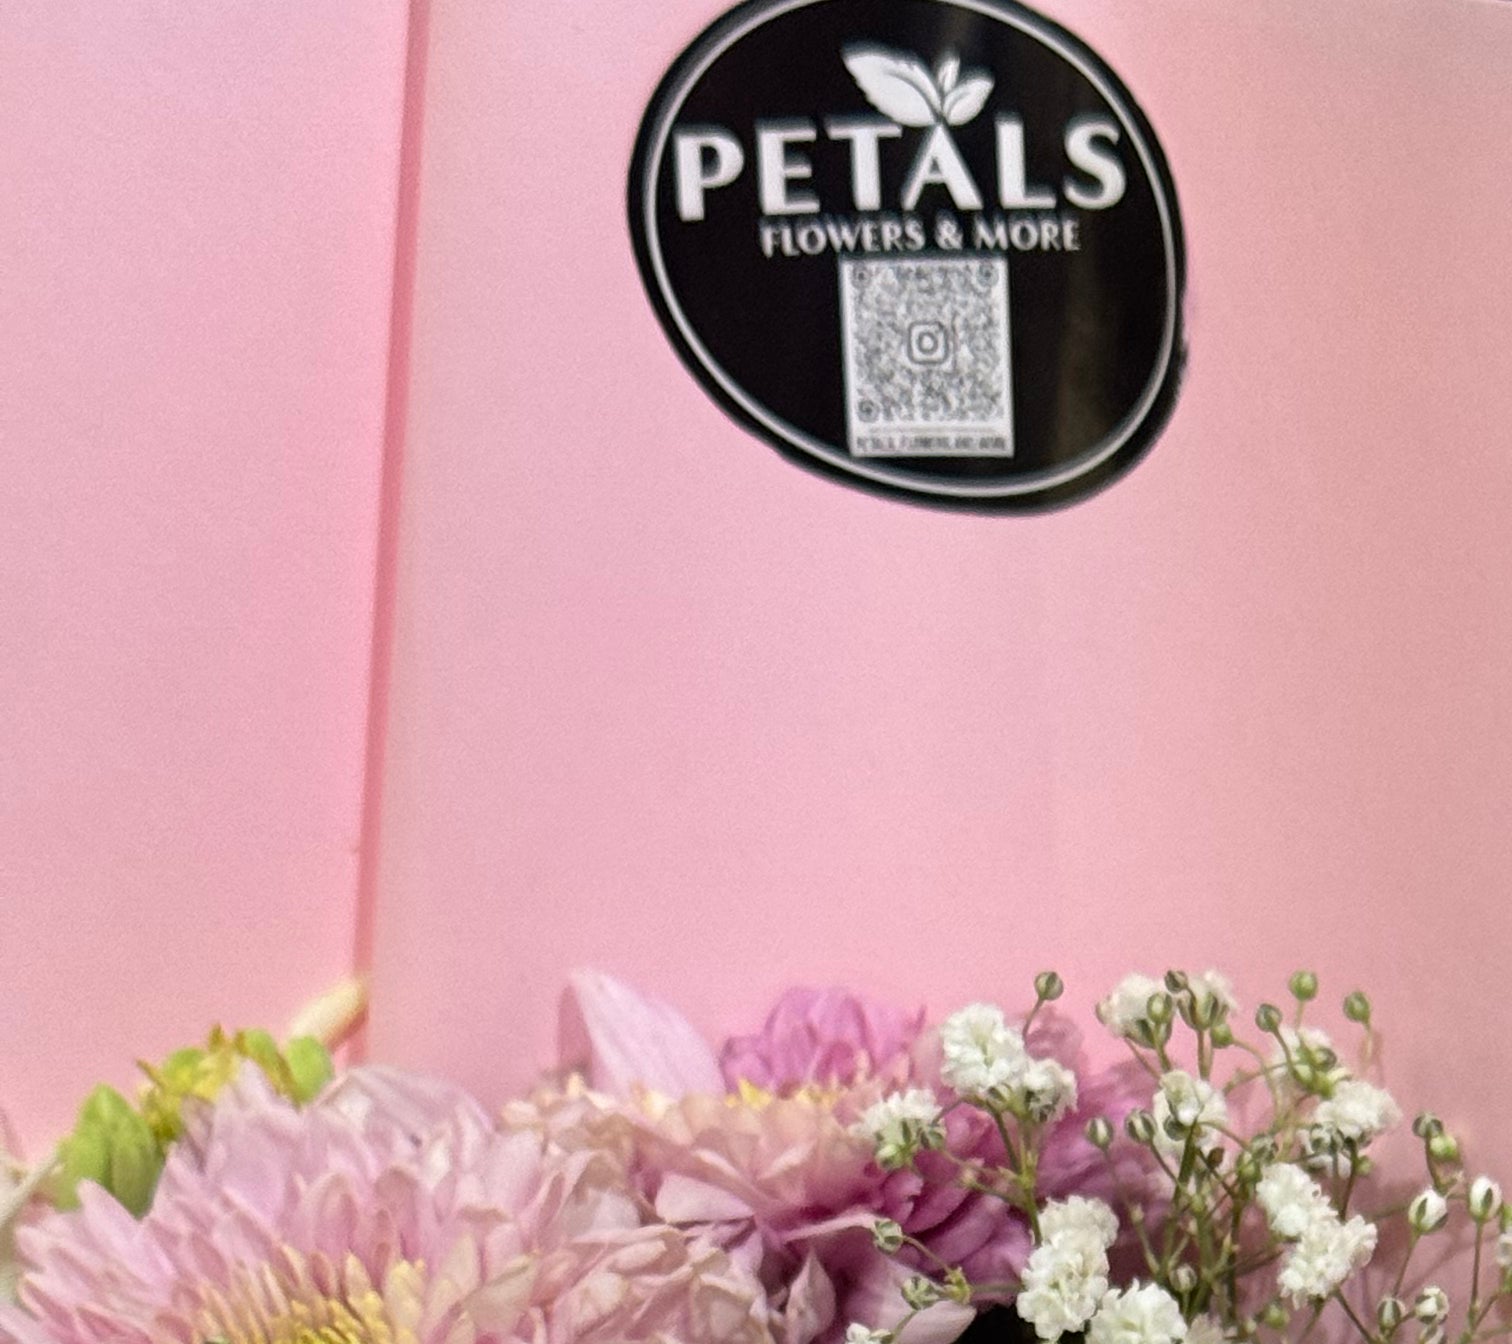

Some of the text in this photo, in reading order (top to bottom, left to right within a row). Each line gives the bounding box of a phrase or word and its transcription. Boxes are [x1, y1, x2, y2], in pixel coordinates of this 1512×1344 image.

[673, 115, 1127, 222] PETALS
[760, 218, 1081, 258] FLOWERS & MORE
